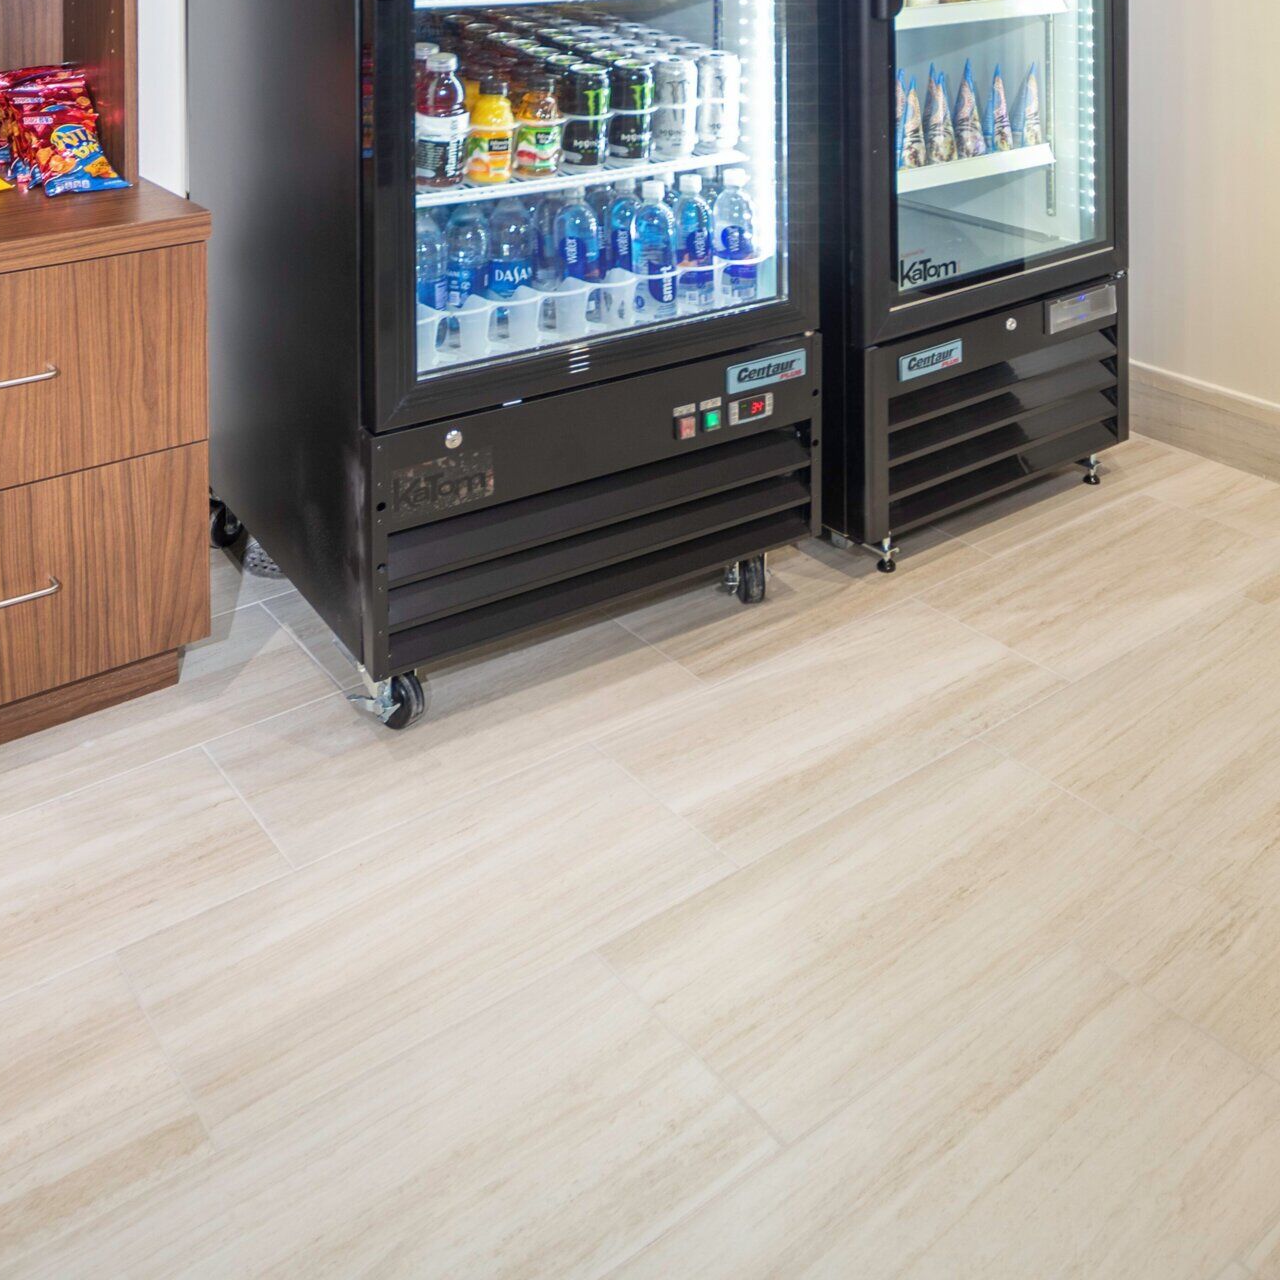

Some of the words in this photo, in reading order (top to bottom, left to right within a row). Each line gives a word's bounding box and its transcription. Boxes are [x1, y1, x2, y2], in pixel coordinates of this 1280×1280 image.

[900, 258, 957, 287] KaTom
[737, 358, 796, 383] Centaur
[908, 347, 956, 371] Centaur
